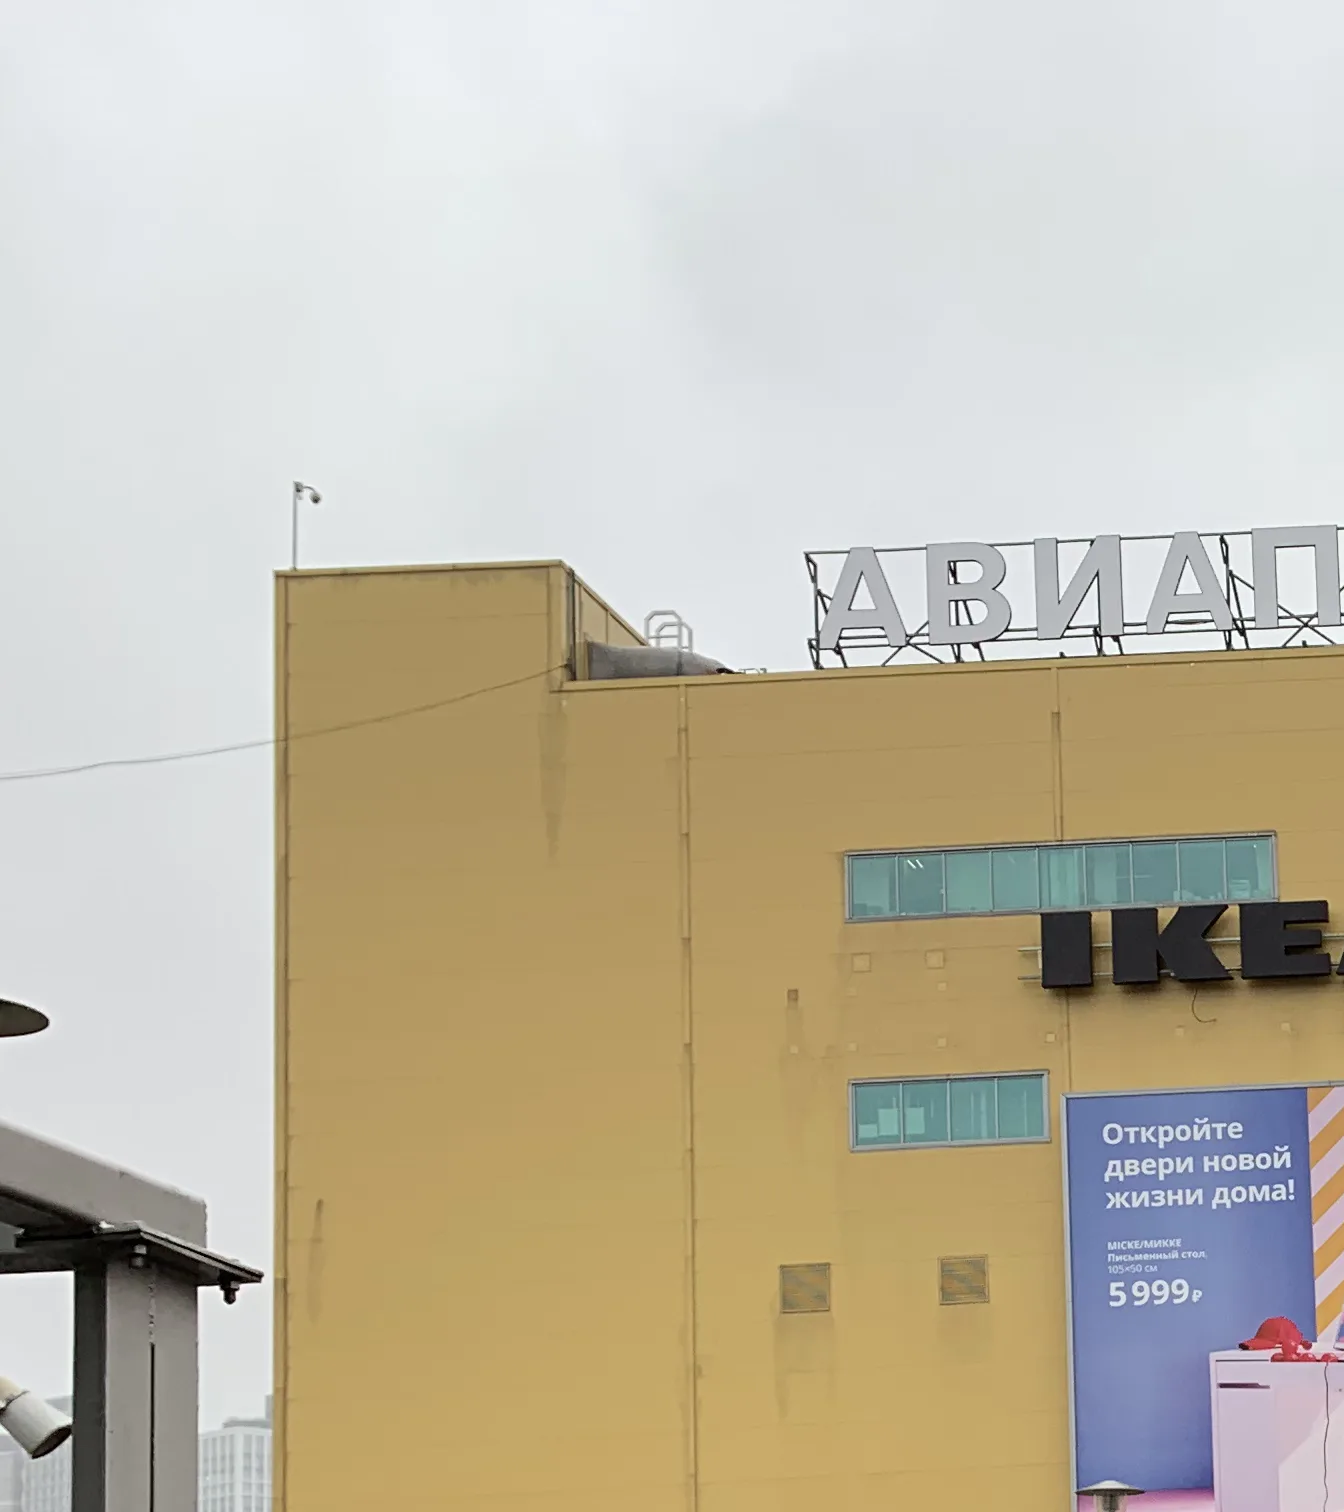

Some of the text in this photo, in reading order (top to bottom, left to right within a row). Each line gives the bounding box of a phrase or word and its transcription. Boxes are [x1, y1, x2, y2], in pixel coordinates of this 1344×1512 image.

[1103, 1118, 1243, 1149] Откройте
[1104, 1145, 1291, 1182] двери новой
[1106, 1179, 1295, 1210] жизни дома!
[1107, 1250, 1179, 1263] Письменный
